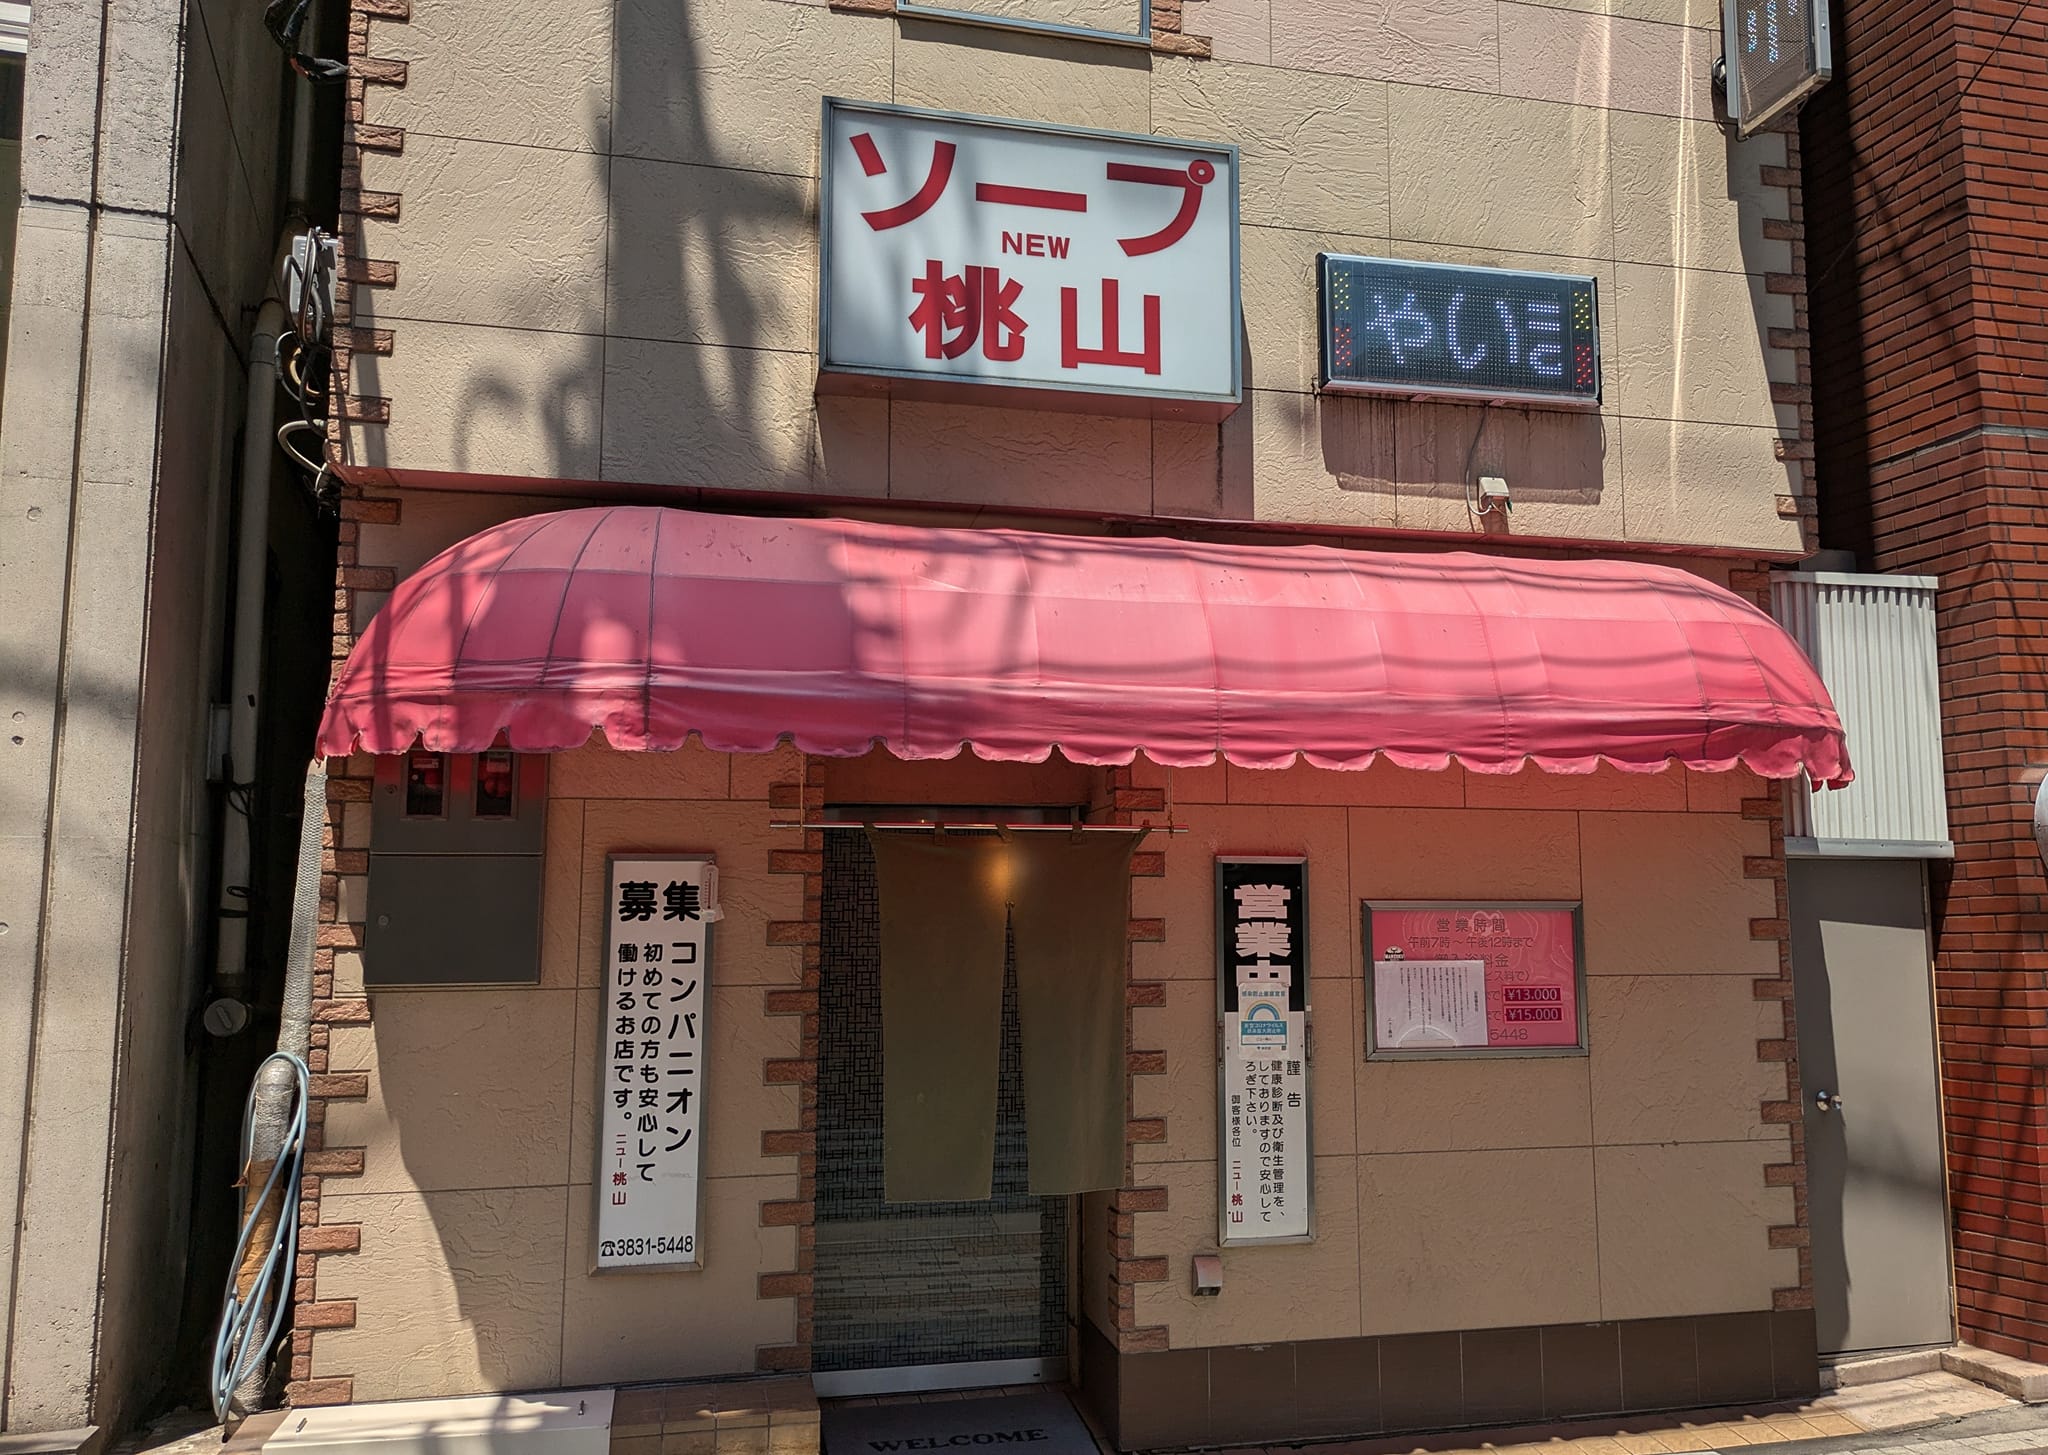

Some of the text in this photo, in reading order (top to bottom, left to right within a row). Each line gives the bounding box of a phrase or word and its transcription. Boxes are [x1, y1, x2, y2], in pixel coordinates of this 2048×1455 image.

[849, 132, 1216, 257] ソープ
[1001, 231, 1071, 260] NEW
[907, 259, 1162, 376] 桃山
[618, 880, 701, 922] 募集
[1437, 918, 1506, 933] 営業時間
[664, 942, 697, 1152] コンパニオン
[1507, 988, 1558, 1001] ¥13.000
[1509, 1008, 1559, 1021] ¥15.000
[611, 943, 638, 1206] 働けるお店です。 ニュー桃山
[636, 943, 664, 1182] 初めての方も安心して
[1231, 1094, 1244, 1224] 御客様各位 ニュー桃山
[1258, 1061, 1272, 1223] しておりますので安心して
[1270, 1060, 1286, 1217] 健康診断及び衛生管理を、
[616, 1235, 694, 1257] 3831-5448
[867, 1428, 1049, 1452] WELCOME
